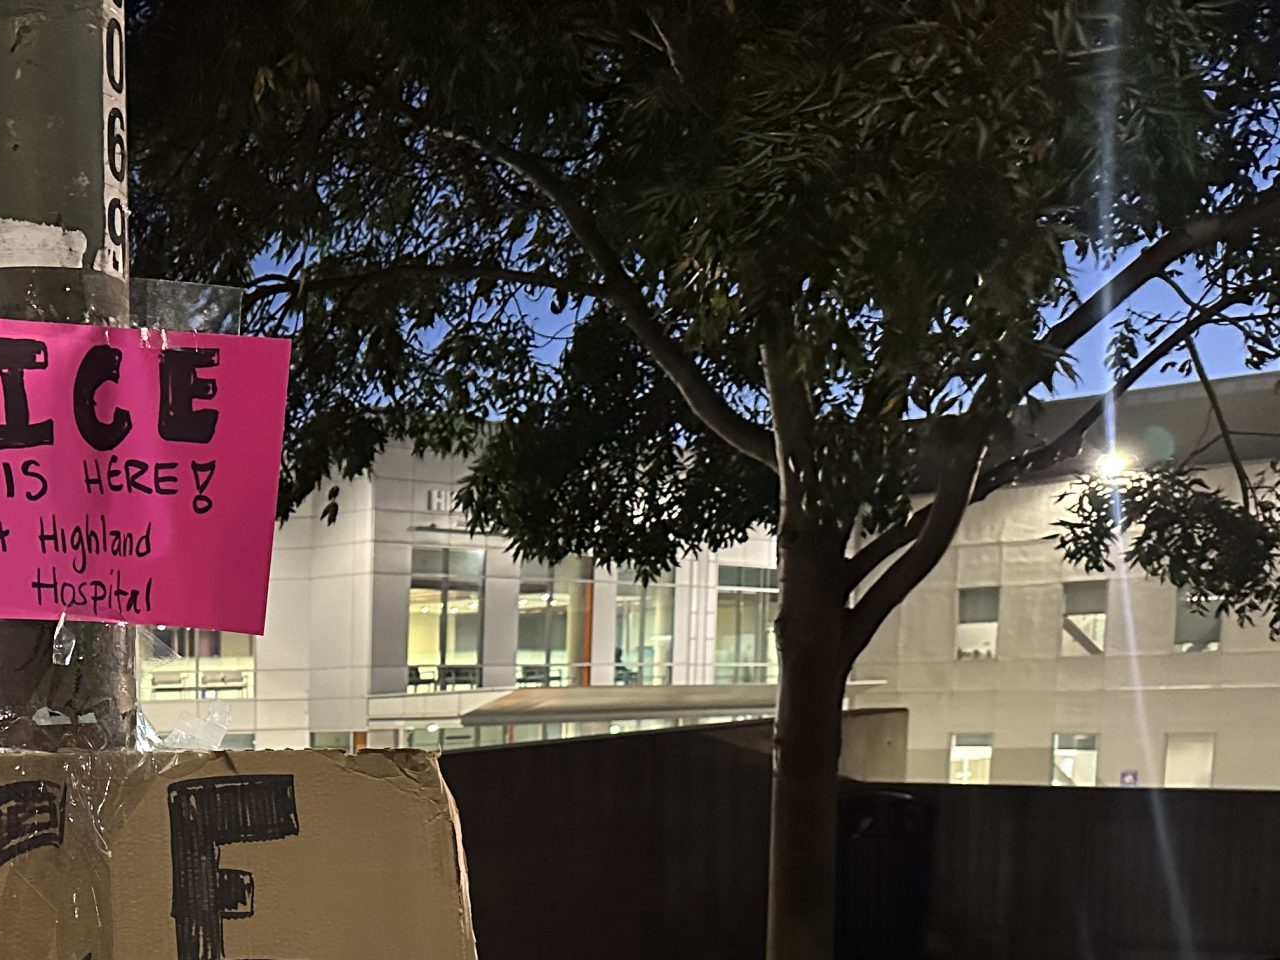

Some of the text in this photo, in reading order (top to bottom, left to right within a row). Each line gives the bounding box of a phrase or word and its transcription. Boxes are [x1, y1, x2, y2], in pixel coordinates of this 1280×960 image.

[3, 455, 216, 514] IS HERE!
[39, 514, 152, 574] Highland
[31, 566, 152, 615] Hospital
